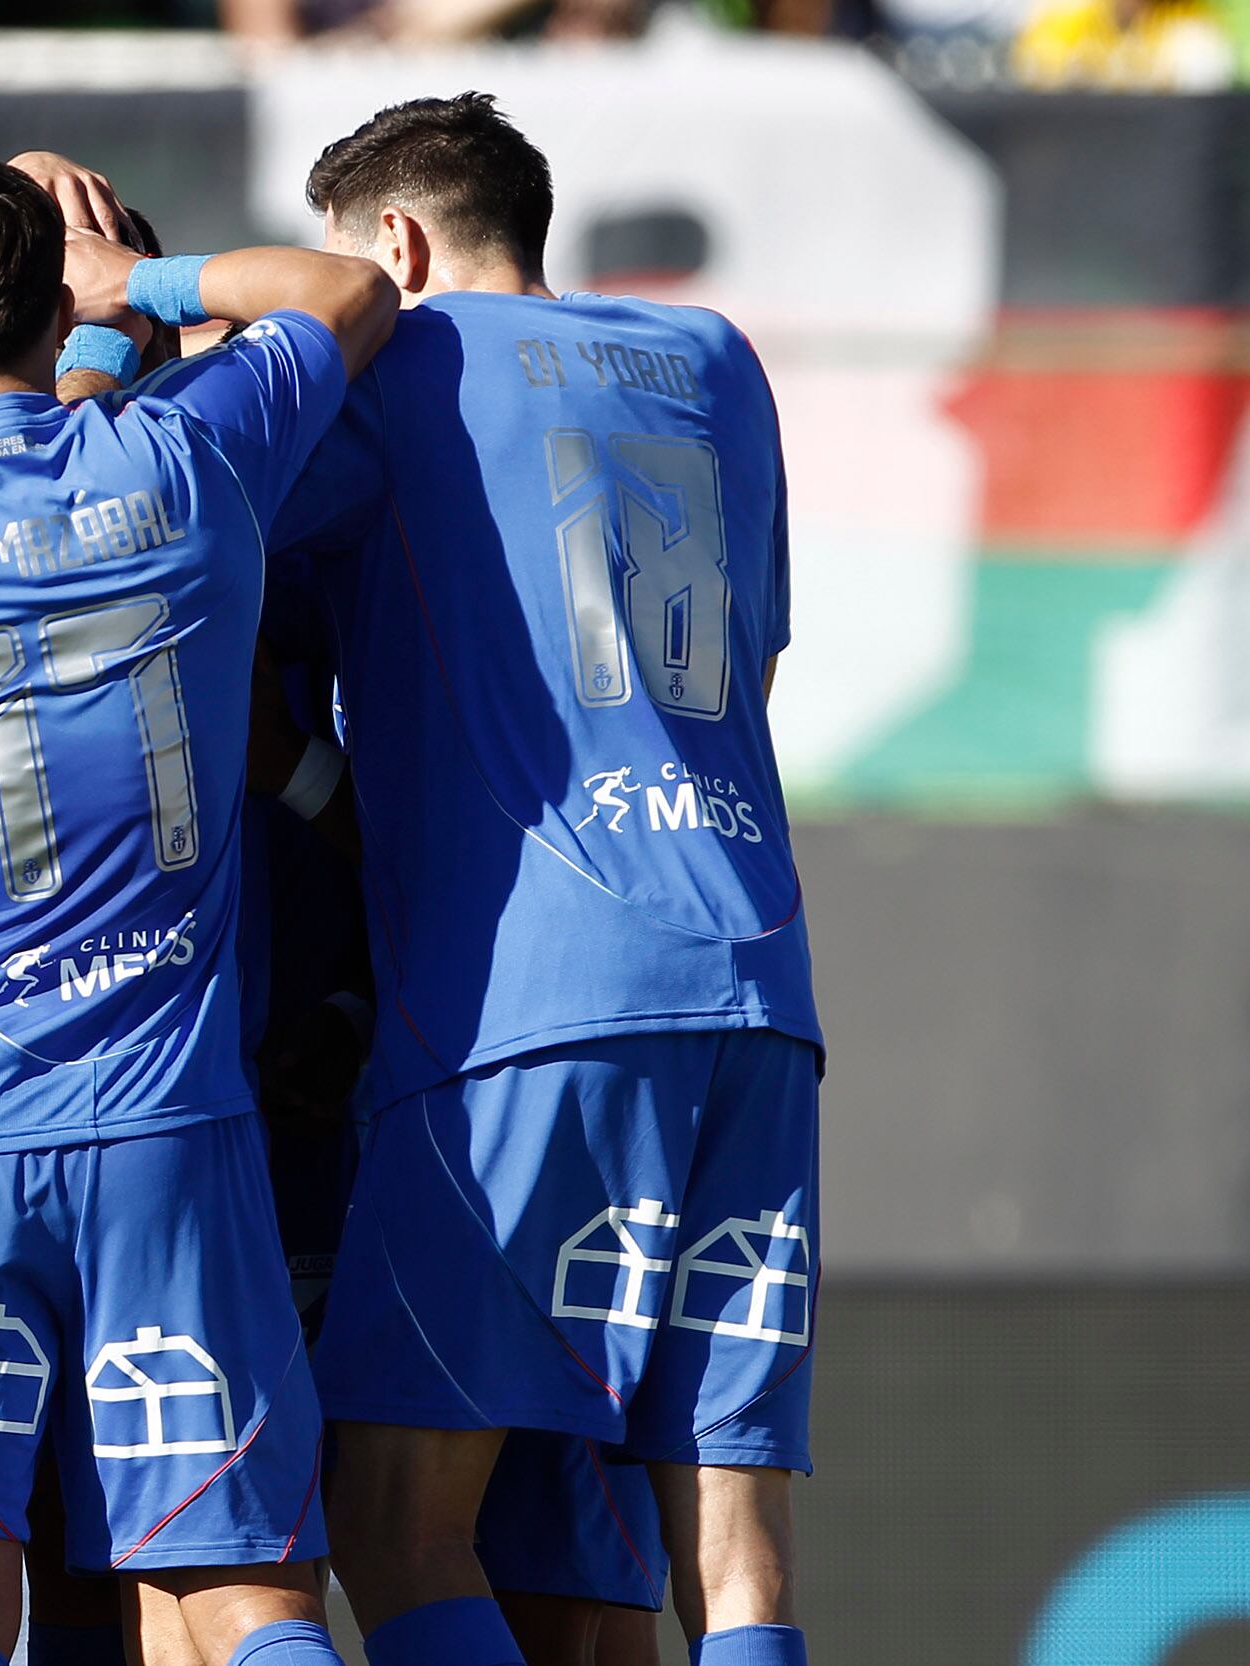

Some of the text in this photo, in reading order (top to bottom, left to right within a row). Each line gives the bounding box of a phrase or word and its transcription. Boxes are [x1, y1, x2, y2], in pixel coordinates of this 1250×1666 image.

[517, 338, 701, 401] DI YORIO
[543, 426, 732, 723] 18
[661, 761, 740, 797] CLNICA
